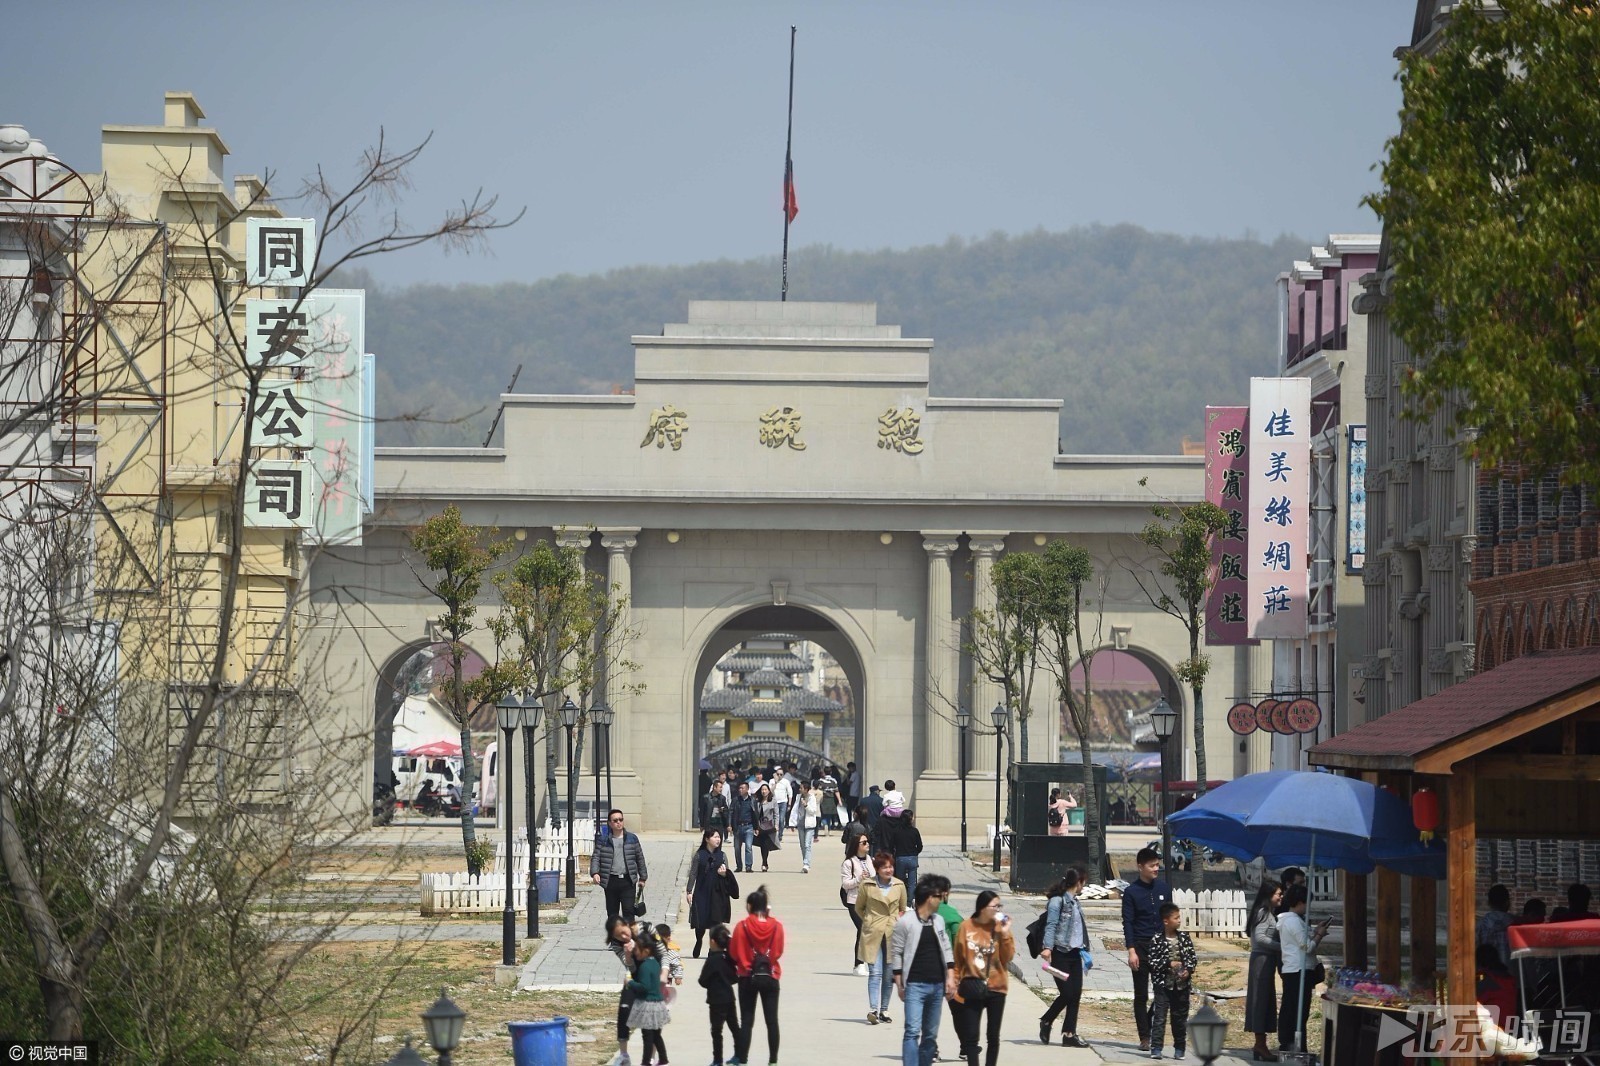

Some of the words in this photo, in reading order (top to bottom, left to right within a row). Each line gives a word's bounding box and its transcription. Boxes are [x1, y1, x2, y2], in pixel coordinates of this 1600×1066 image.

[255, 226, 309, 520] 同安公司
[1262, 408, 1295, 615] 佳美絲綢莊
